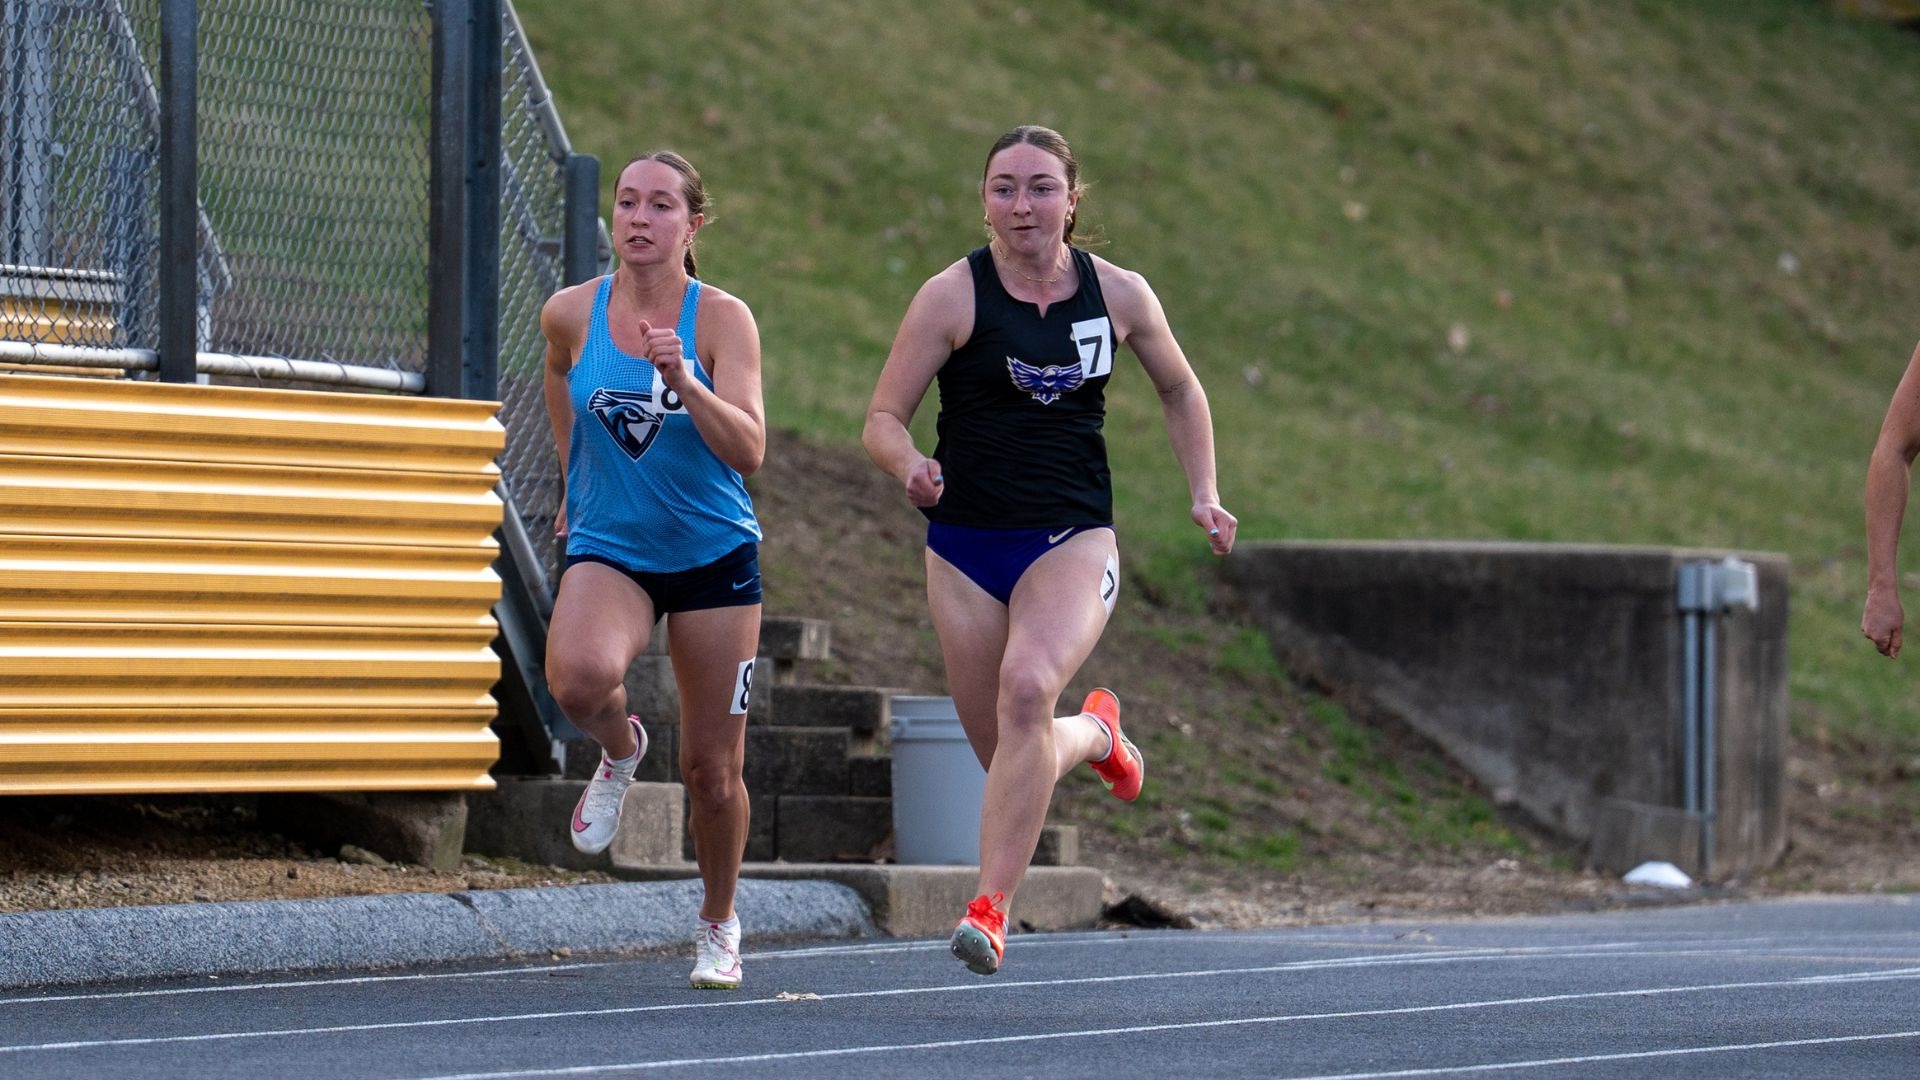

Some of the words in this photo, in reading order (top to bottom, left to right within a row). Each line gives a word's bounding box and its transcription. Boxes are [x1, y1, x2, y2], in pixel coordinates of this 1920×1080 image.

[1078, 334, 1103, 375] 7
[1102, 569, 1116, 602] 7
[739, 661, 754, 711] 8
